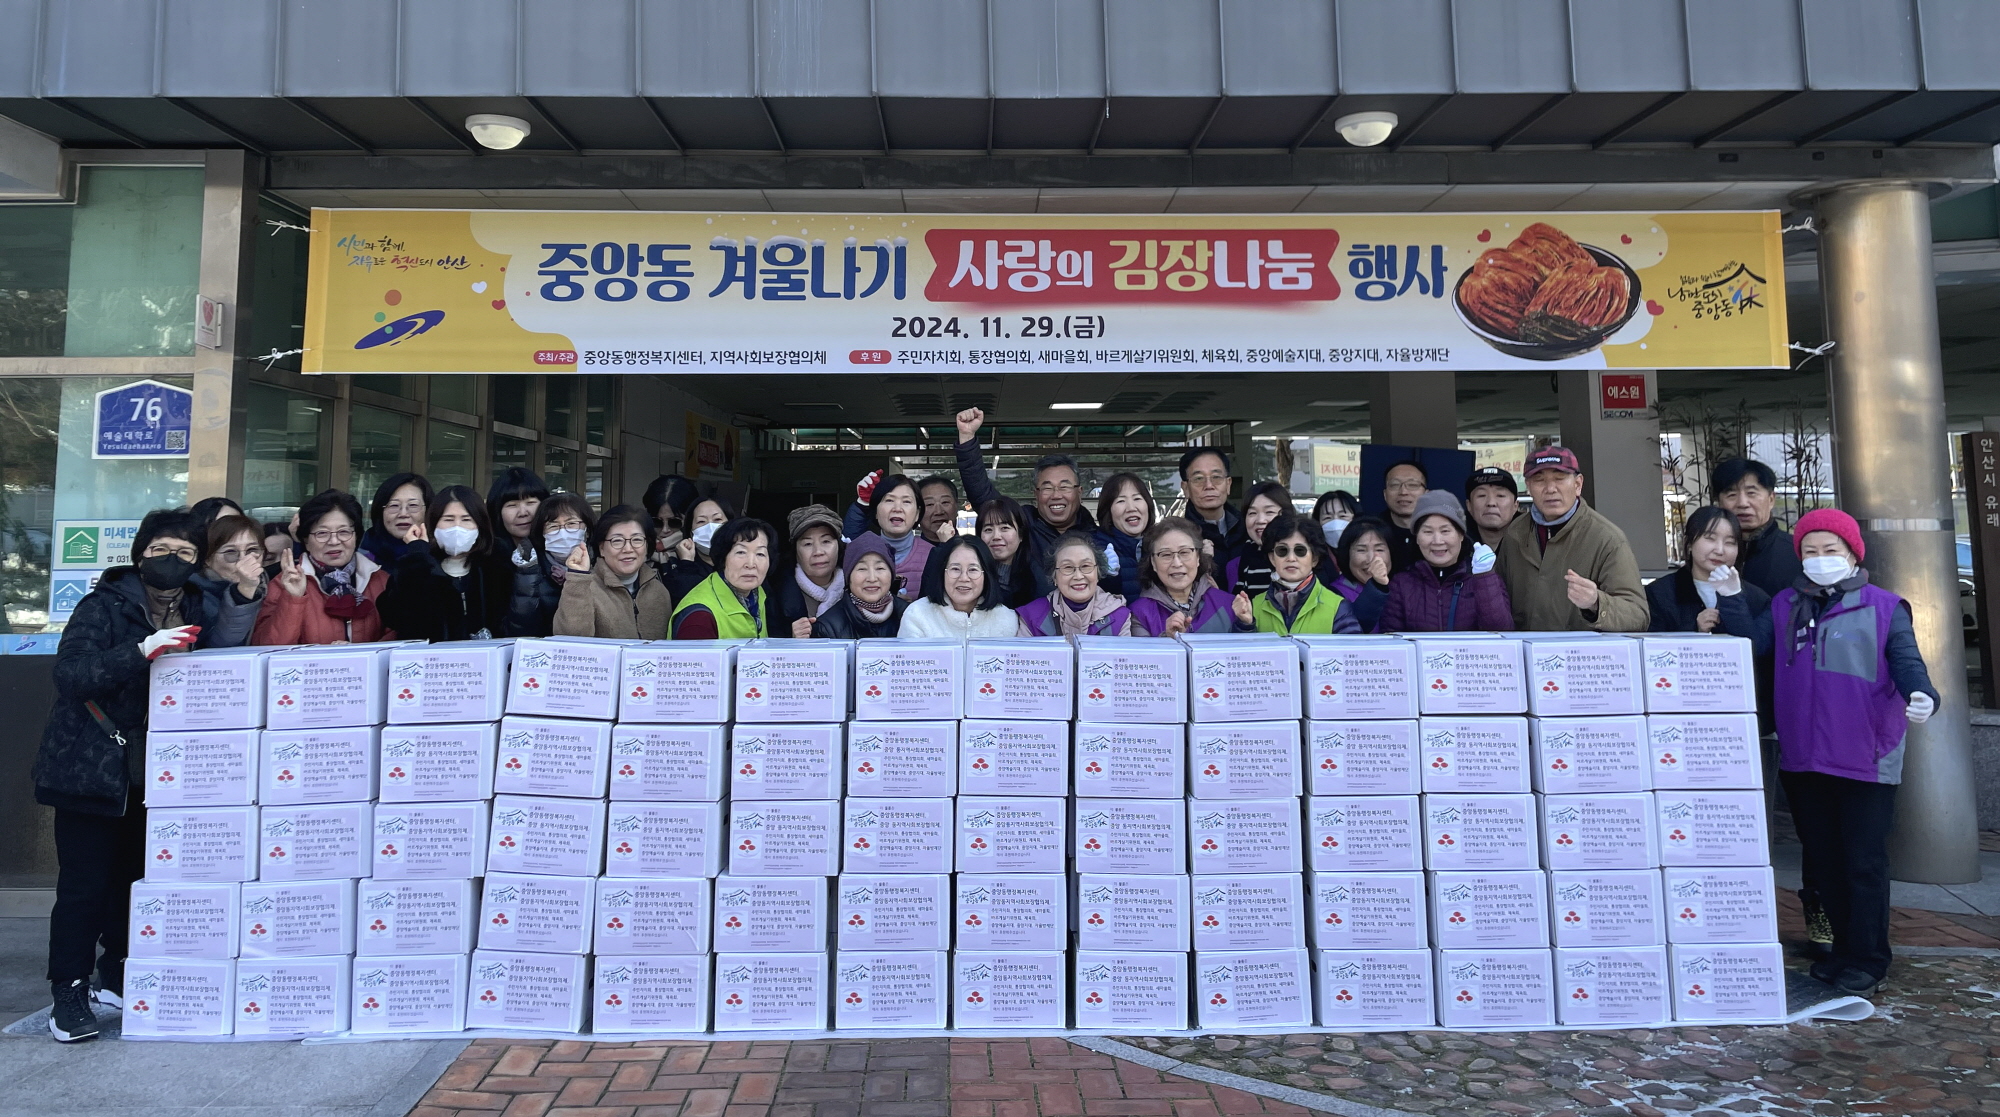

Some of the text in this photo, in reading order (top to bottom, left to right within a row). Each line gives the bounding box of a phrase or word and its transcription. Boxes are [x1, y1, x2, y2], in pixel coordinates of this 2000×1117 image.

[336, 234, 377, 256] 시민과
[390, 255, 433, 272] 혁신도시
[437, 255, 471, 270] 안산
[537, 238, 1448, 302] 중앙동 겨울나기 사랑의 김장나눔 행사
[1692, 301, 1734, 320] 중앙동
[891, 315, 1105, 339] 2024. 11. 29.(금)
[537, 351, 575, 363] 주최/주관
[584, 349, 827, 366] 중앙동행정복지센터, 지역사회보장협의체
[897, 348, 1450, 365] 주민자치회, 통장협의회, 새마을회, 바르게살기위원회, 체육회, 중앙예술지대, 중앙지대, 자율방재단
[1607, 385, 1640, 400] 에스원
[130, 397, 162, 422] 76
[103, 431, 154, 442] 예술대학로
[1980, 438, 1999, 526] 안산시 유래
